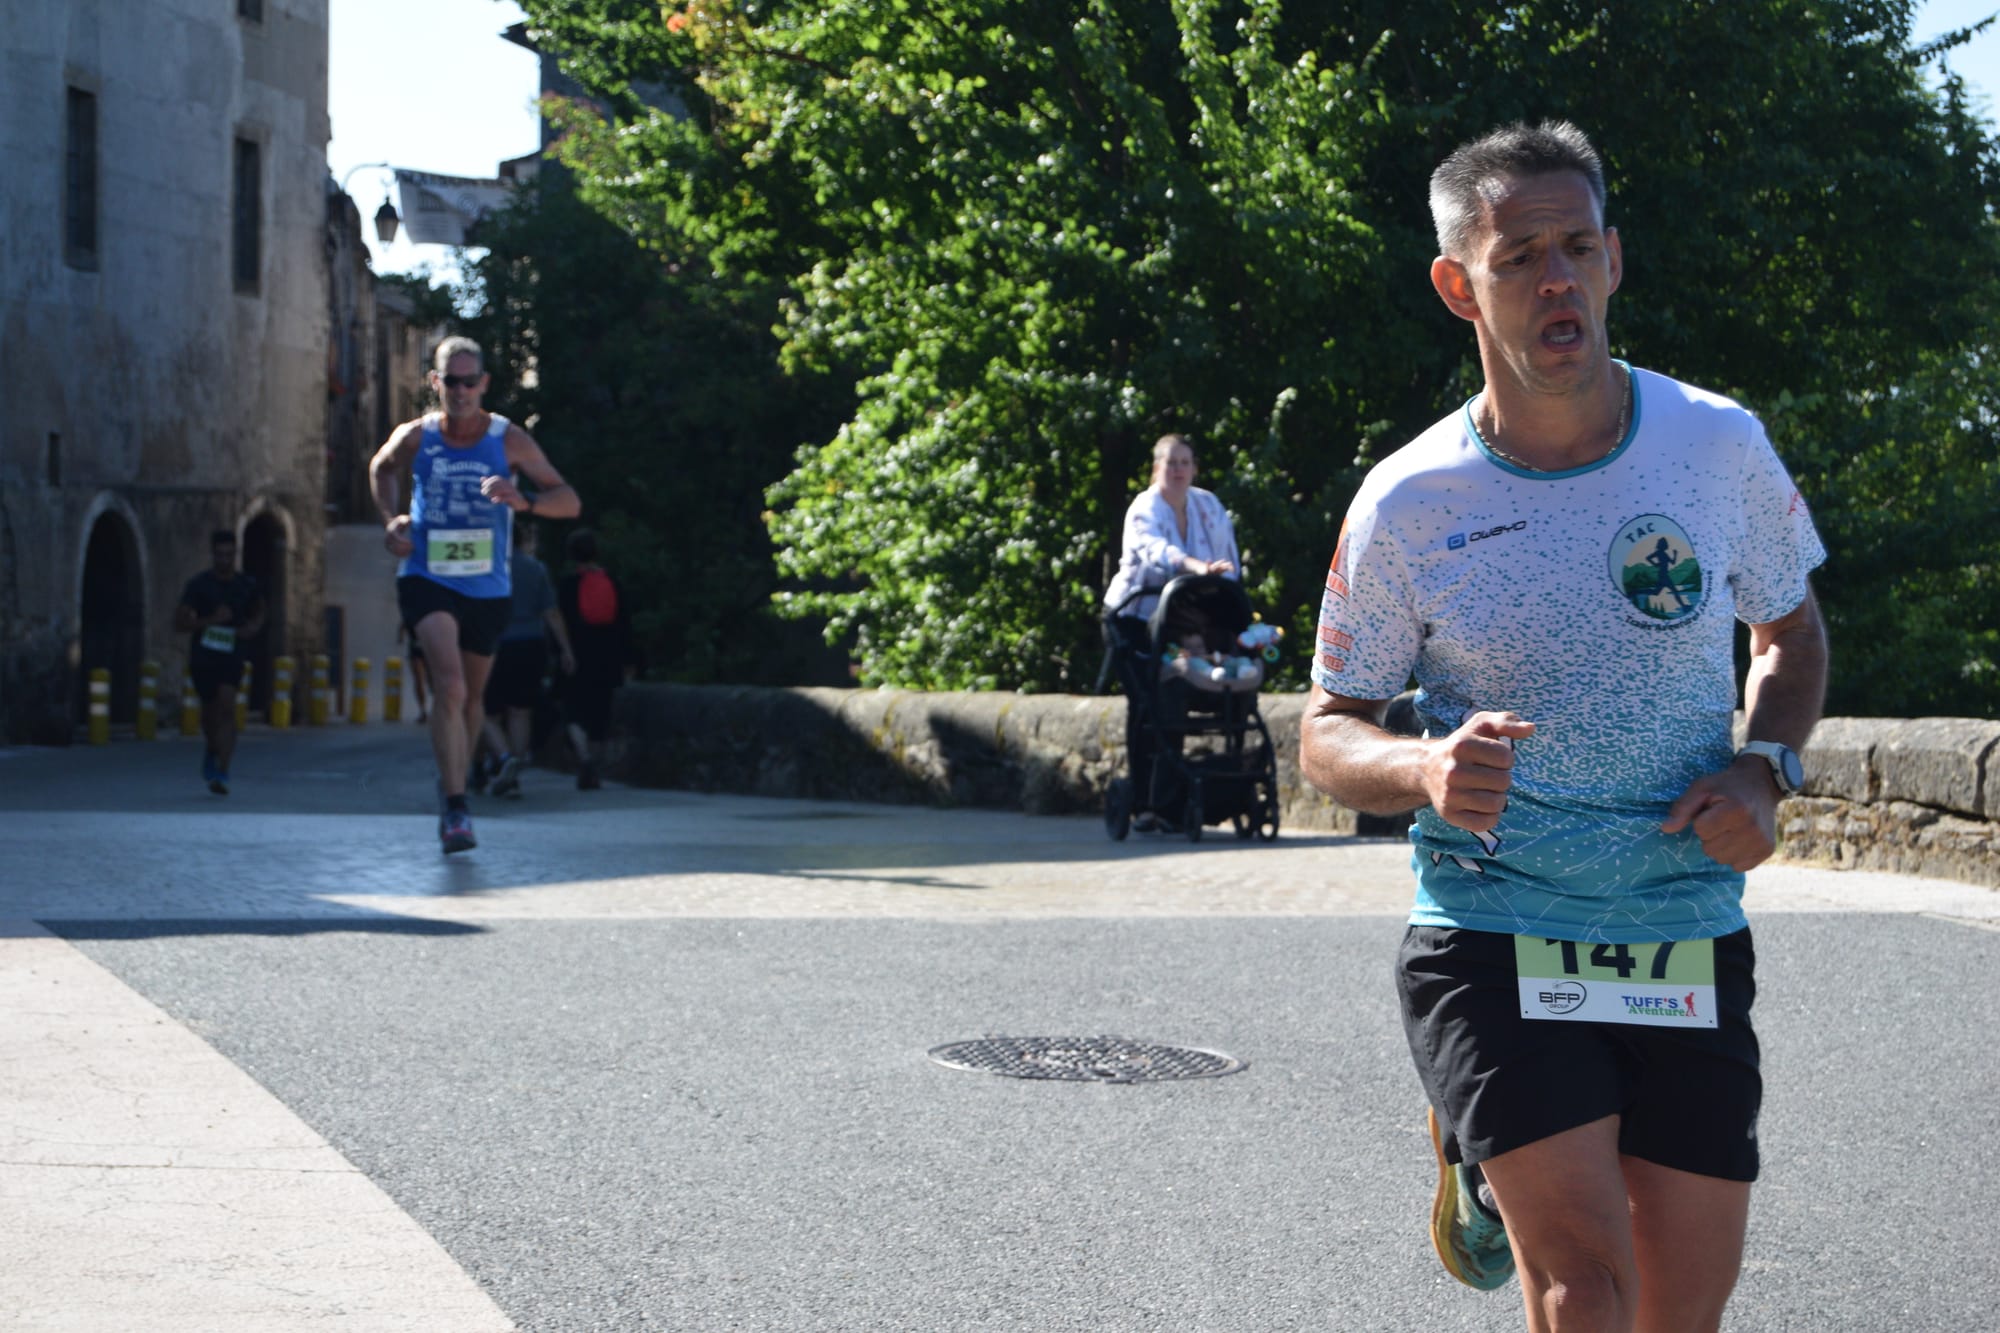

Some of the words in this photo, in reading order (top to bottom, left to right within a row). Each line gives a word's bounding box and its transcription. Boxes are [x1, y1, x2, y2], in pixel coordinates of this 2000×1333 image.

[1625, 522, 1655, 543] TAC
[444, 542, 475, 560] 25
[1545, 938, 1677, 979] 147
[1539, 992, 1580, 1004] BFP
[1621, 995, 1678, 1009] TUFF'S
[1628, 1003, 1686, 1017] Aventure
